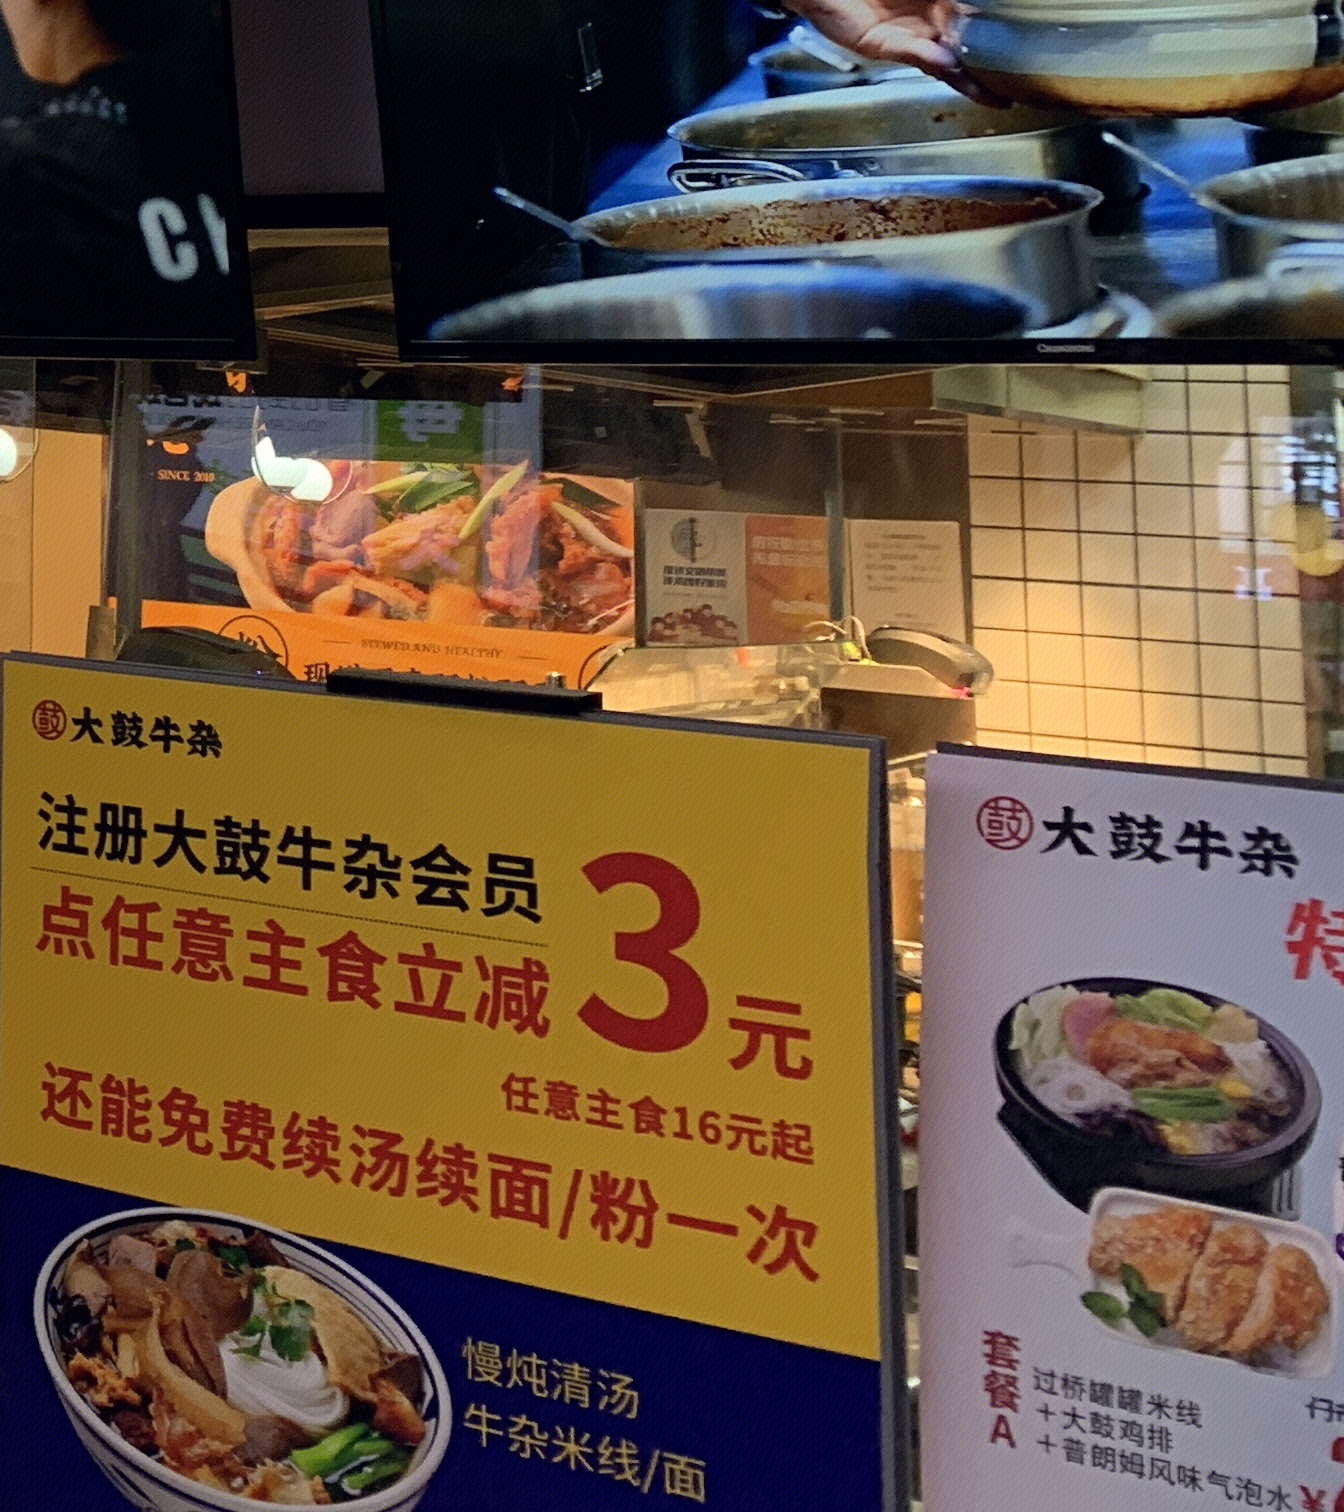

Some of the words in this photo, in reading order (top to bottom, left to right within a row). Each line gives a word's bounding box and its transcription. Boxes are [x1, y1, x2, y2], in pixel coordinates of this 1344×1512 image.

[157, 469, 191, 482] SINCE
[69, 705, 224, 760] 大鼓牛杂
[35, 790, 543, 925] 注册大鼓牛杂会员
[1040, 804, 1301, 881] 大鼓牛杂
[33, 885, 554, 1041] 点任意主食立减
[501, 1073, 817, 1167] 任意主食16元起
[39, 1060, 821, 1284] 还能免费续汤续面/粉一次
[461, 1336, 642, 1421] 慢炖清汤
[1031, 1366, 1204, 1430] 过桥罐罐米线
[462, 1404, 708, 1507] 牛杂米线/面
